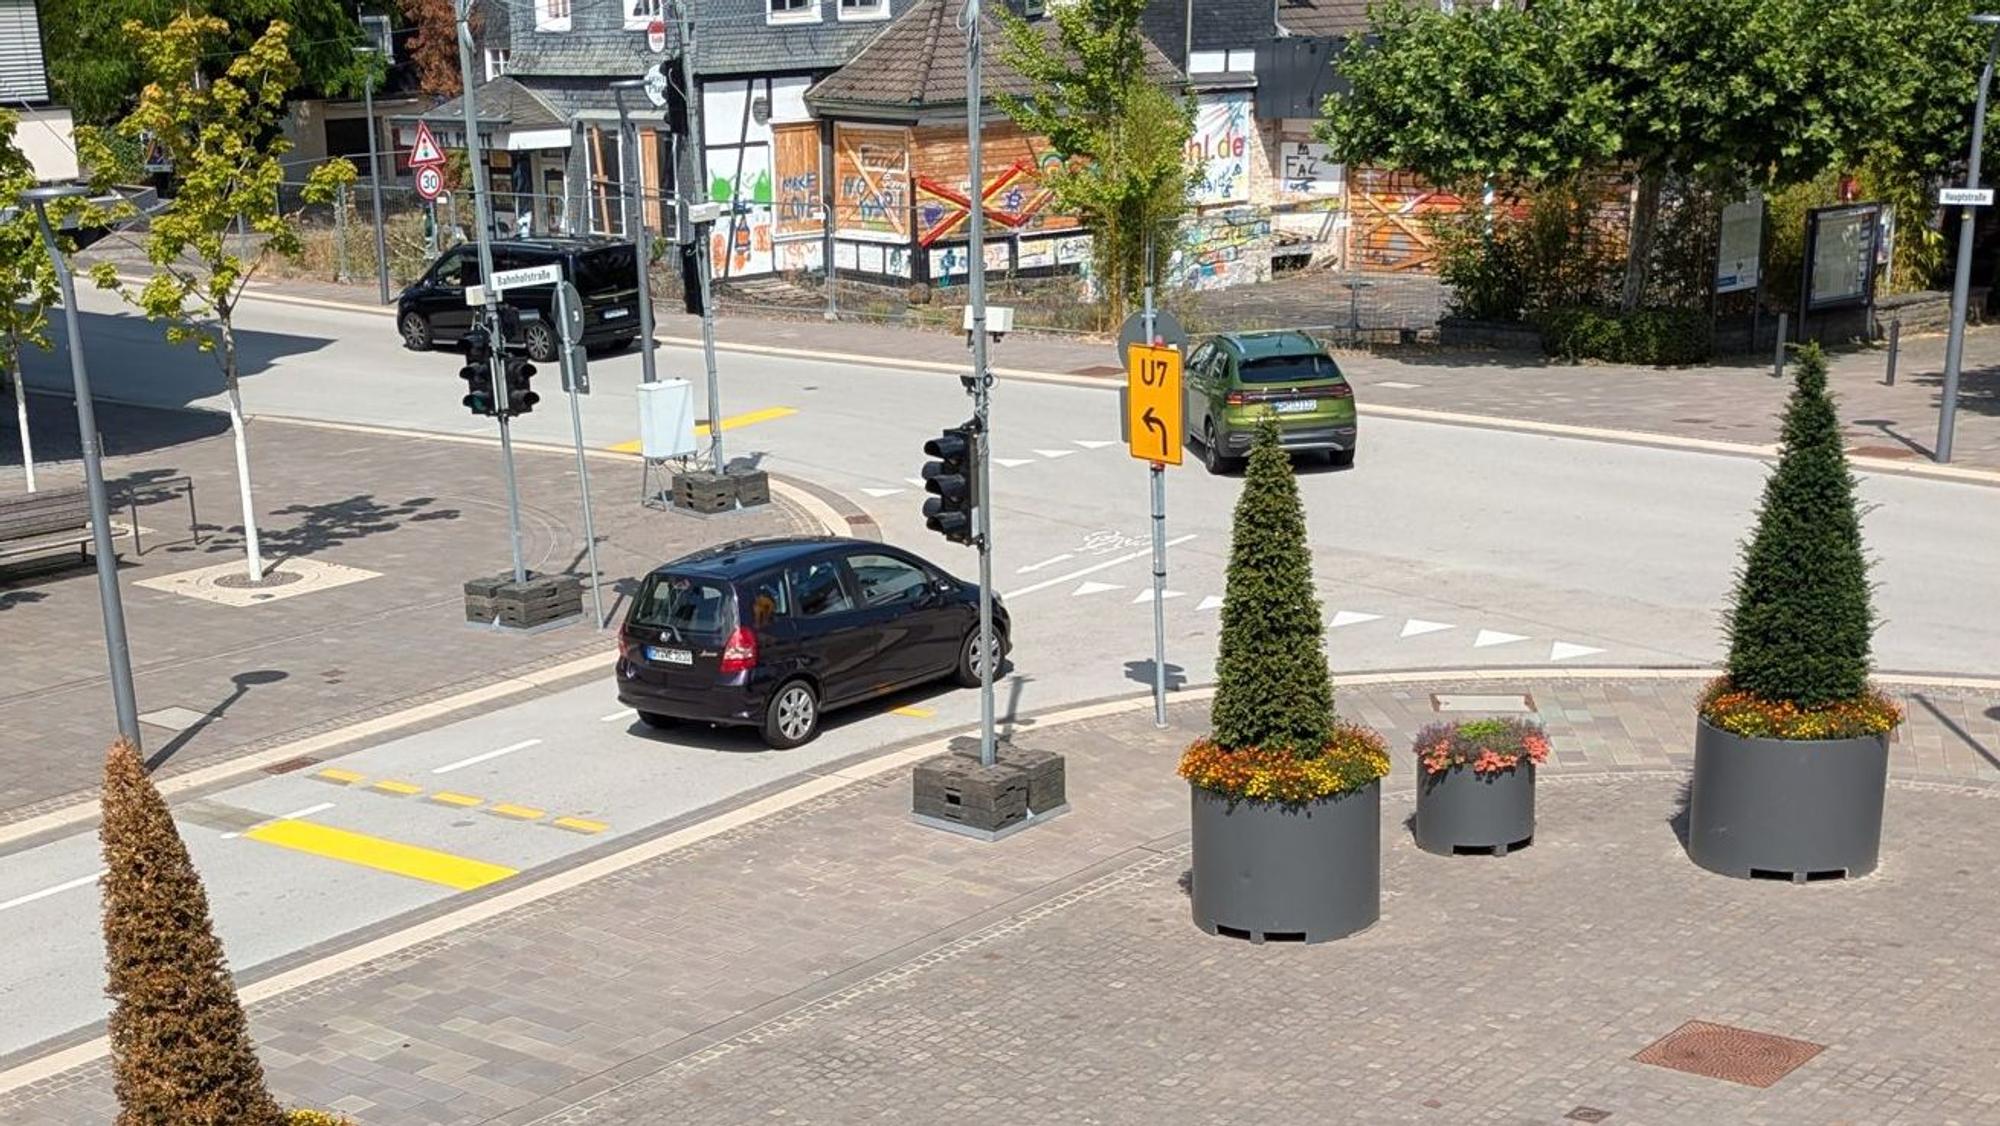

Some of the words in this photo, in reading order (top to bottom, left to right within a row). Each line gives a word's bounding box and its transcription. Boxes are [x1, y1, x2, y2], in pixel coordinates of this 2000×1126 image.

[1182, 131, 1246, 161] hl.de
[422, 174, 437, 190] 30
[496, 269, 551, 287] Bahnhofstraße
[1141, 358, 1168, 388] U7
